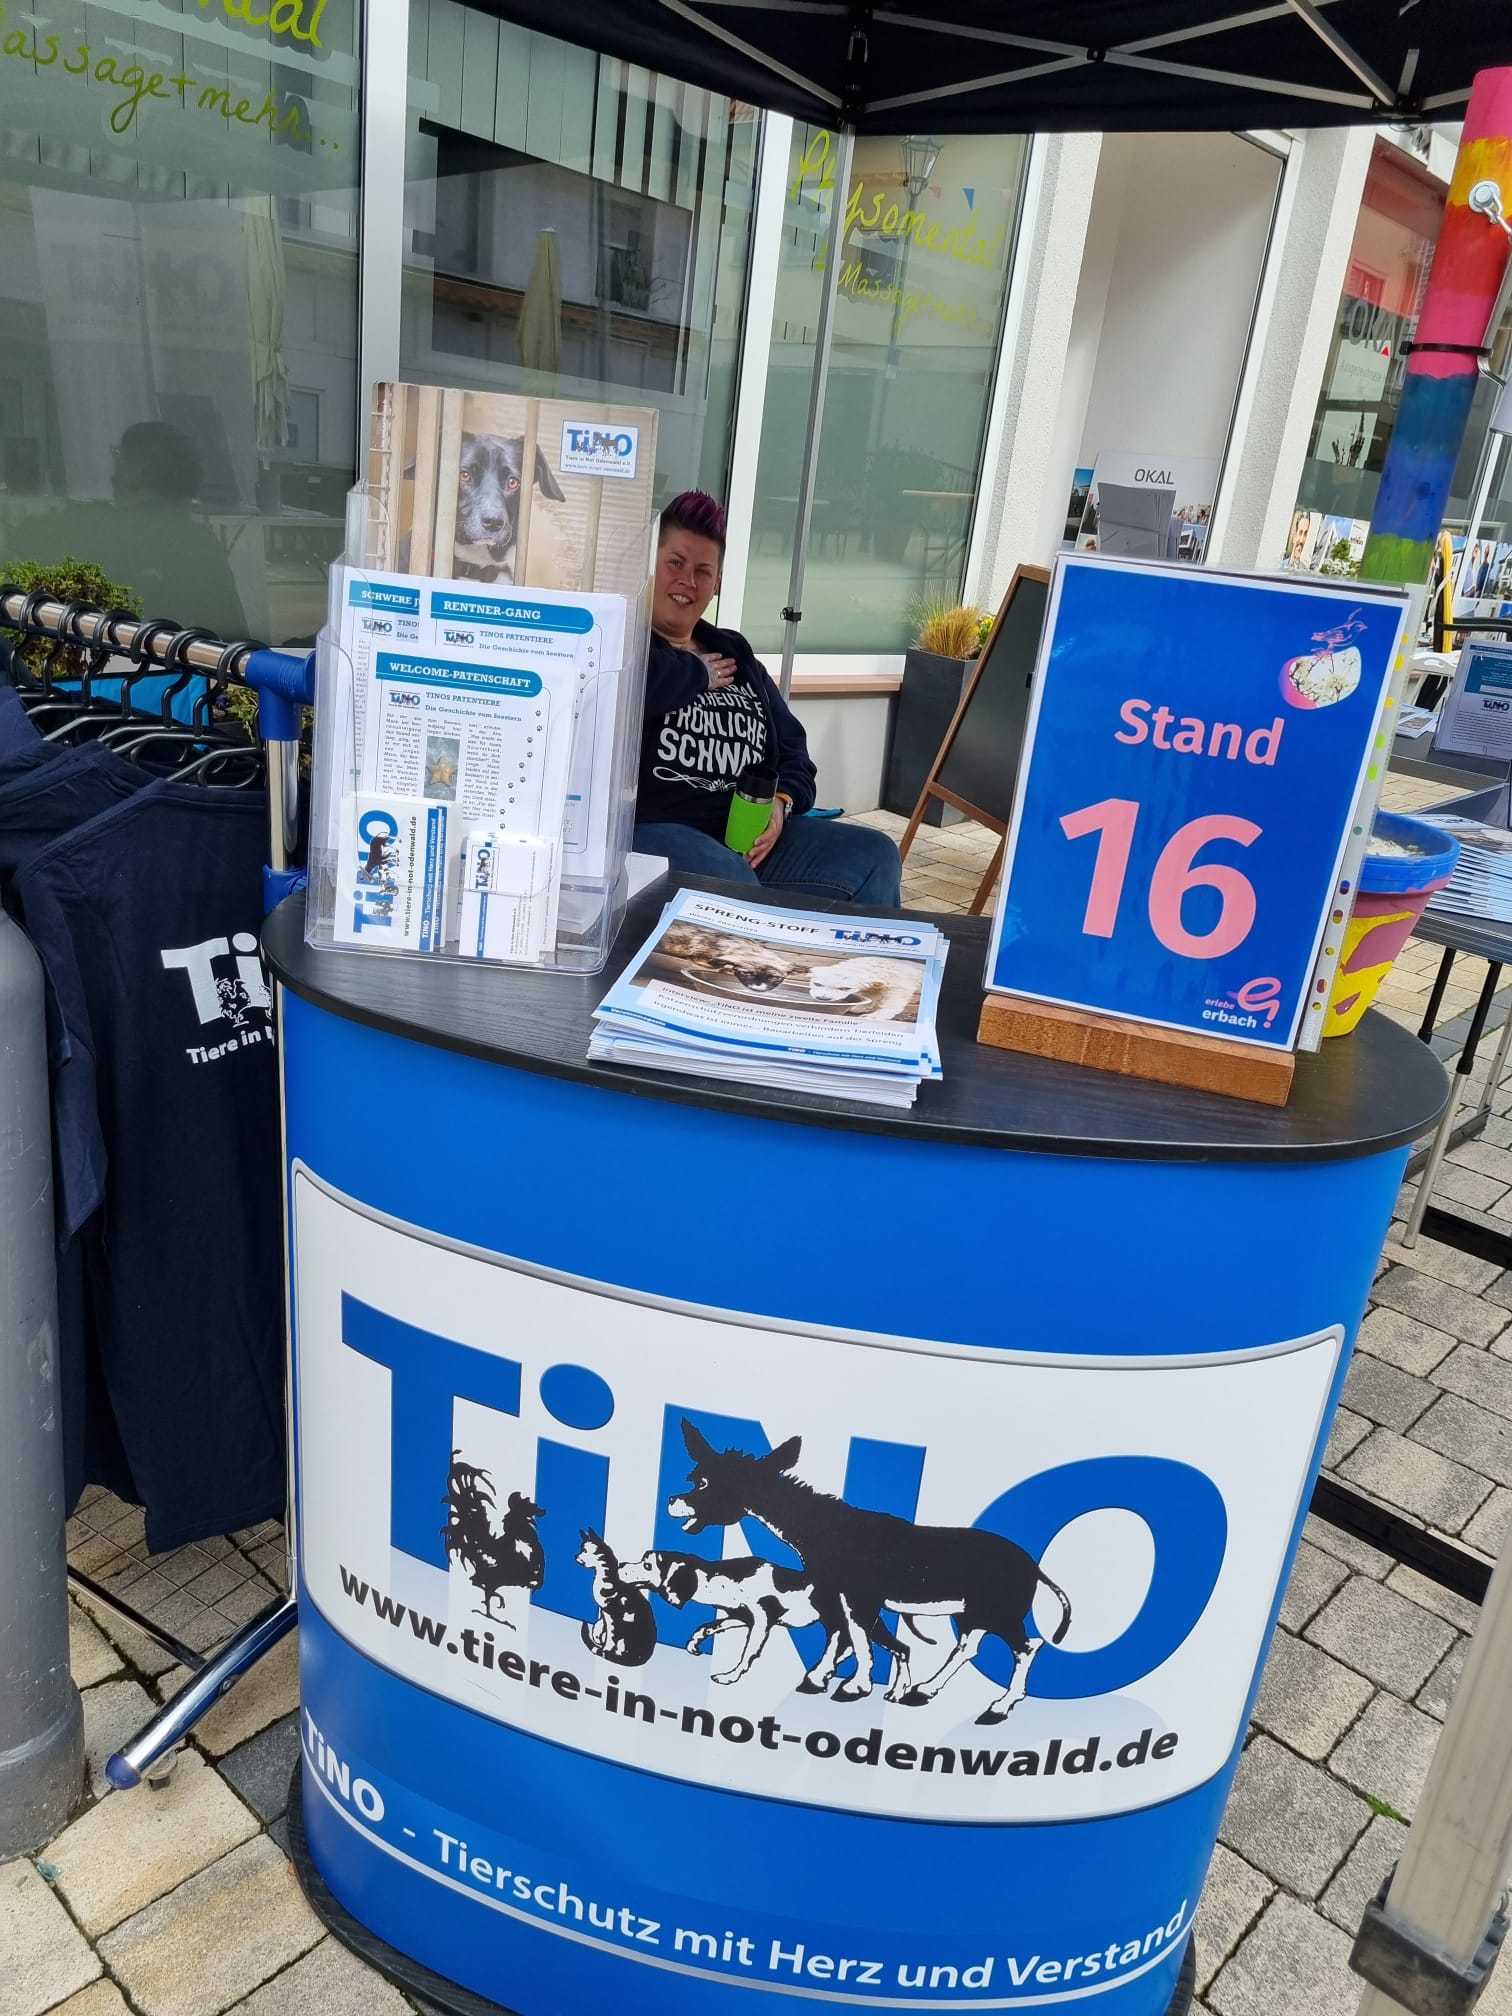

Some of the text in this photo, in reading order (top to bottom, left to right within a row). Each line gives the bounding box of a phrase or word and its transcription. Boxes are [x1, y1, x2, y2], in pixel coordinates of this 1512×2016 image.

[1134, 468, 1174, 485] OKAL
[361, 590, 413, 605] SCHWERE
[443, 600, 541, 620] RENTNER-GANG
[389, 662, 531, 688] WELCOME-PATENSCHAFT
[704, 692, 752, 711] HEUTE
[1114, 698, 1285, 766] Stand
[1058, 797, 1264, 960] 16
[695, 903, 821, 935] SPRENG-STOFF
[1202, 1009, 1258, 1029] erbach
[186, 1038, 239, 1065] Tiere
[240, 1028, 262, 1046] in
[341, 1289, 1229, 1701] TiNO
[339, 1561, 1179, 1777] www.tiere-in-not-odenwald.de
[303, 1706, 386, 1823] TiNO
[433, 1828, 661, 1946] Tierschutz
[673, 1925, 756, 1966] mit
[768, 1939, 883, 1986] Herz
[896, 1956, 996, 1989] und
[1006, 1898, 1188, 1987] Verstand
